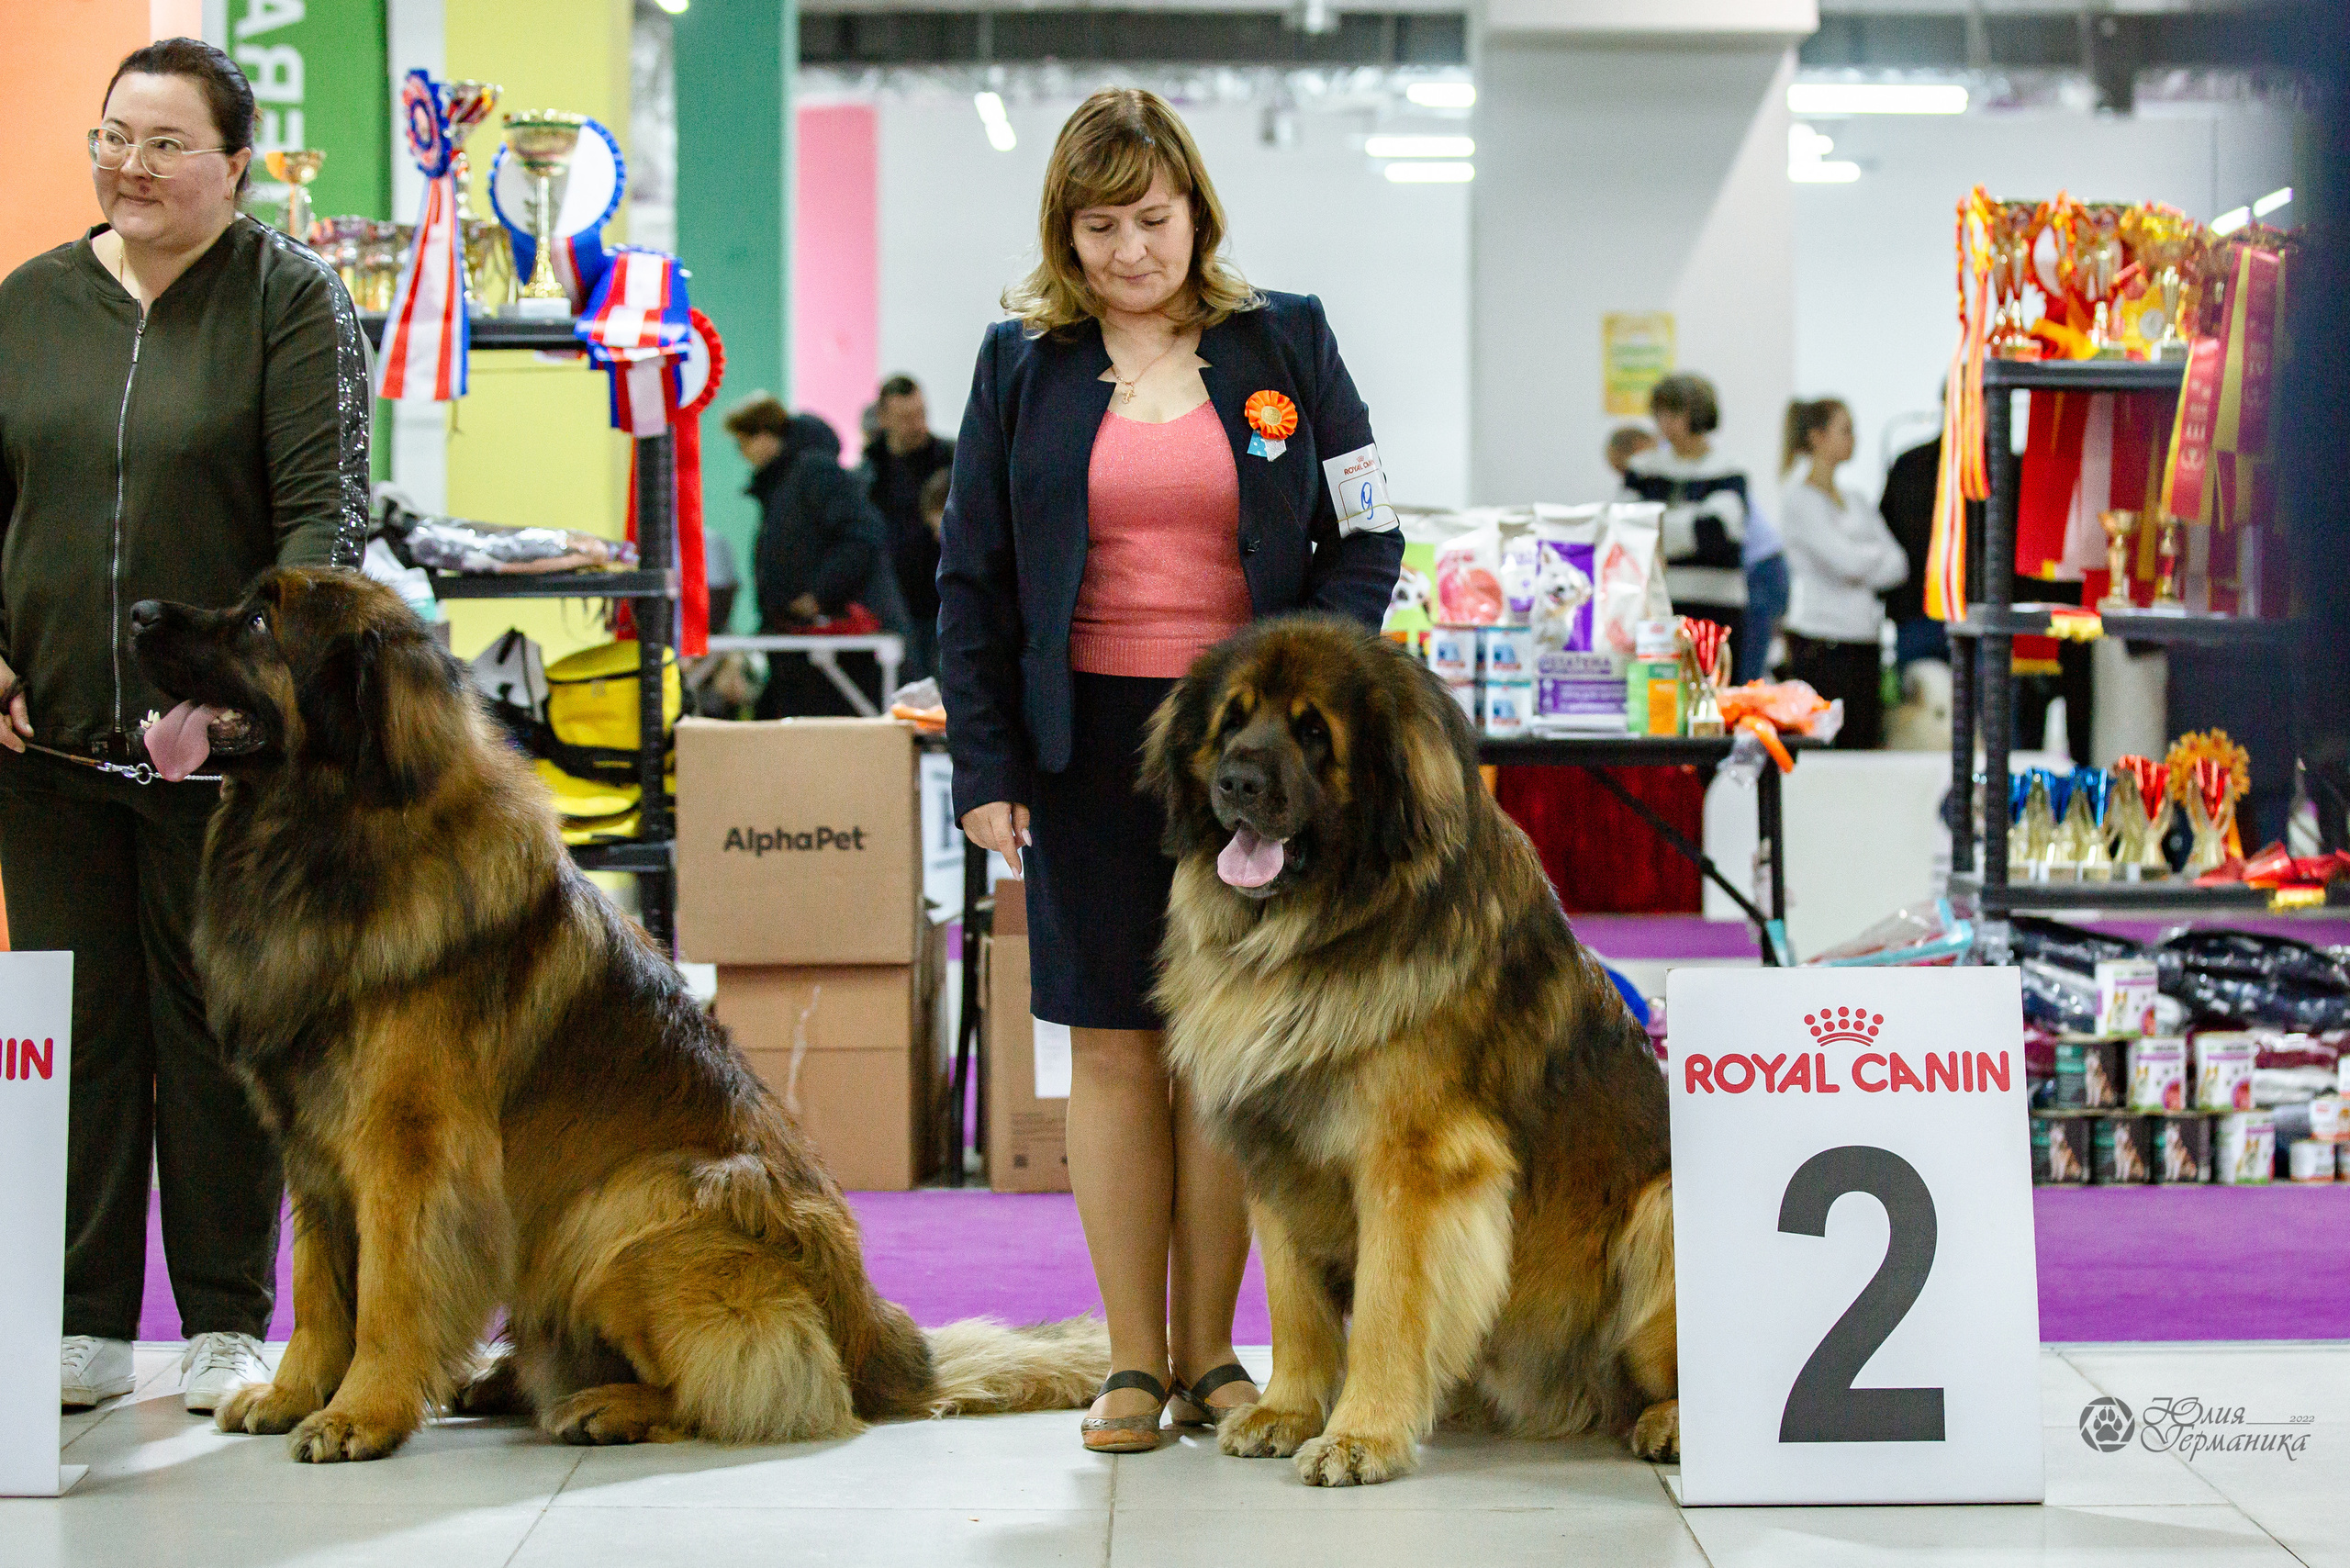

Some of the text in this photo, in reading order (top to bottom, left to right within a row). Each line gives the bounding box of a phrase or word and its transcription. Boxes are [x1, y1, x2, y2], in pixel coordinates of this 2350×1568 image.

[1343, 464, 1363, 476] ROYAL
[723, 826, 866, 857] AlphaPet
[0, 1037, 53, 1081] IN
[1684, 1050, 2011, 1094] ROYAL CANIN
[1776, 1144, 1947, 1443] 2
